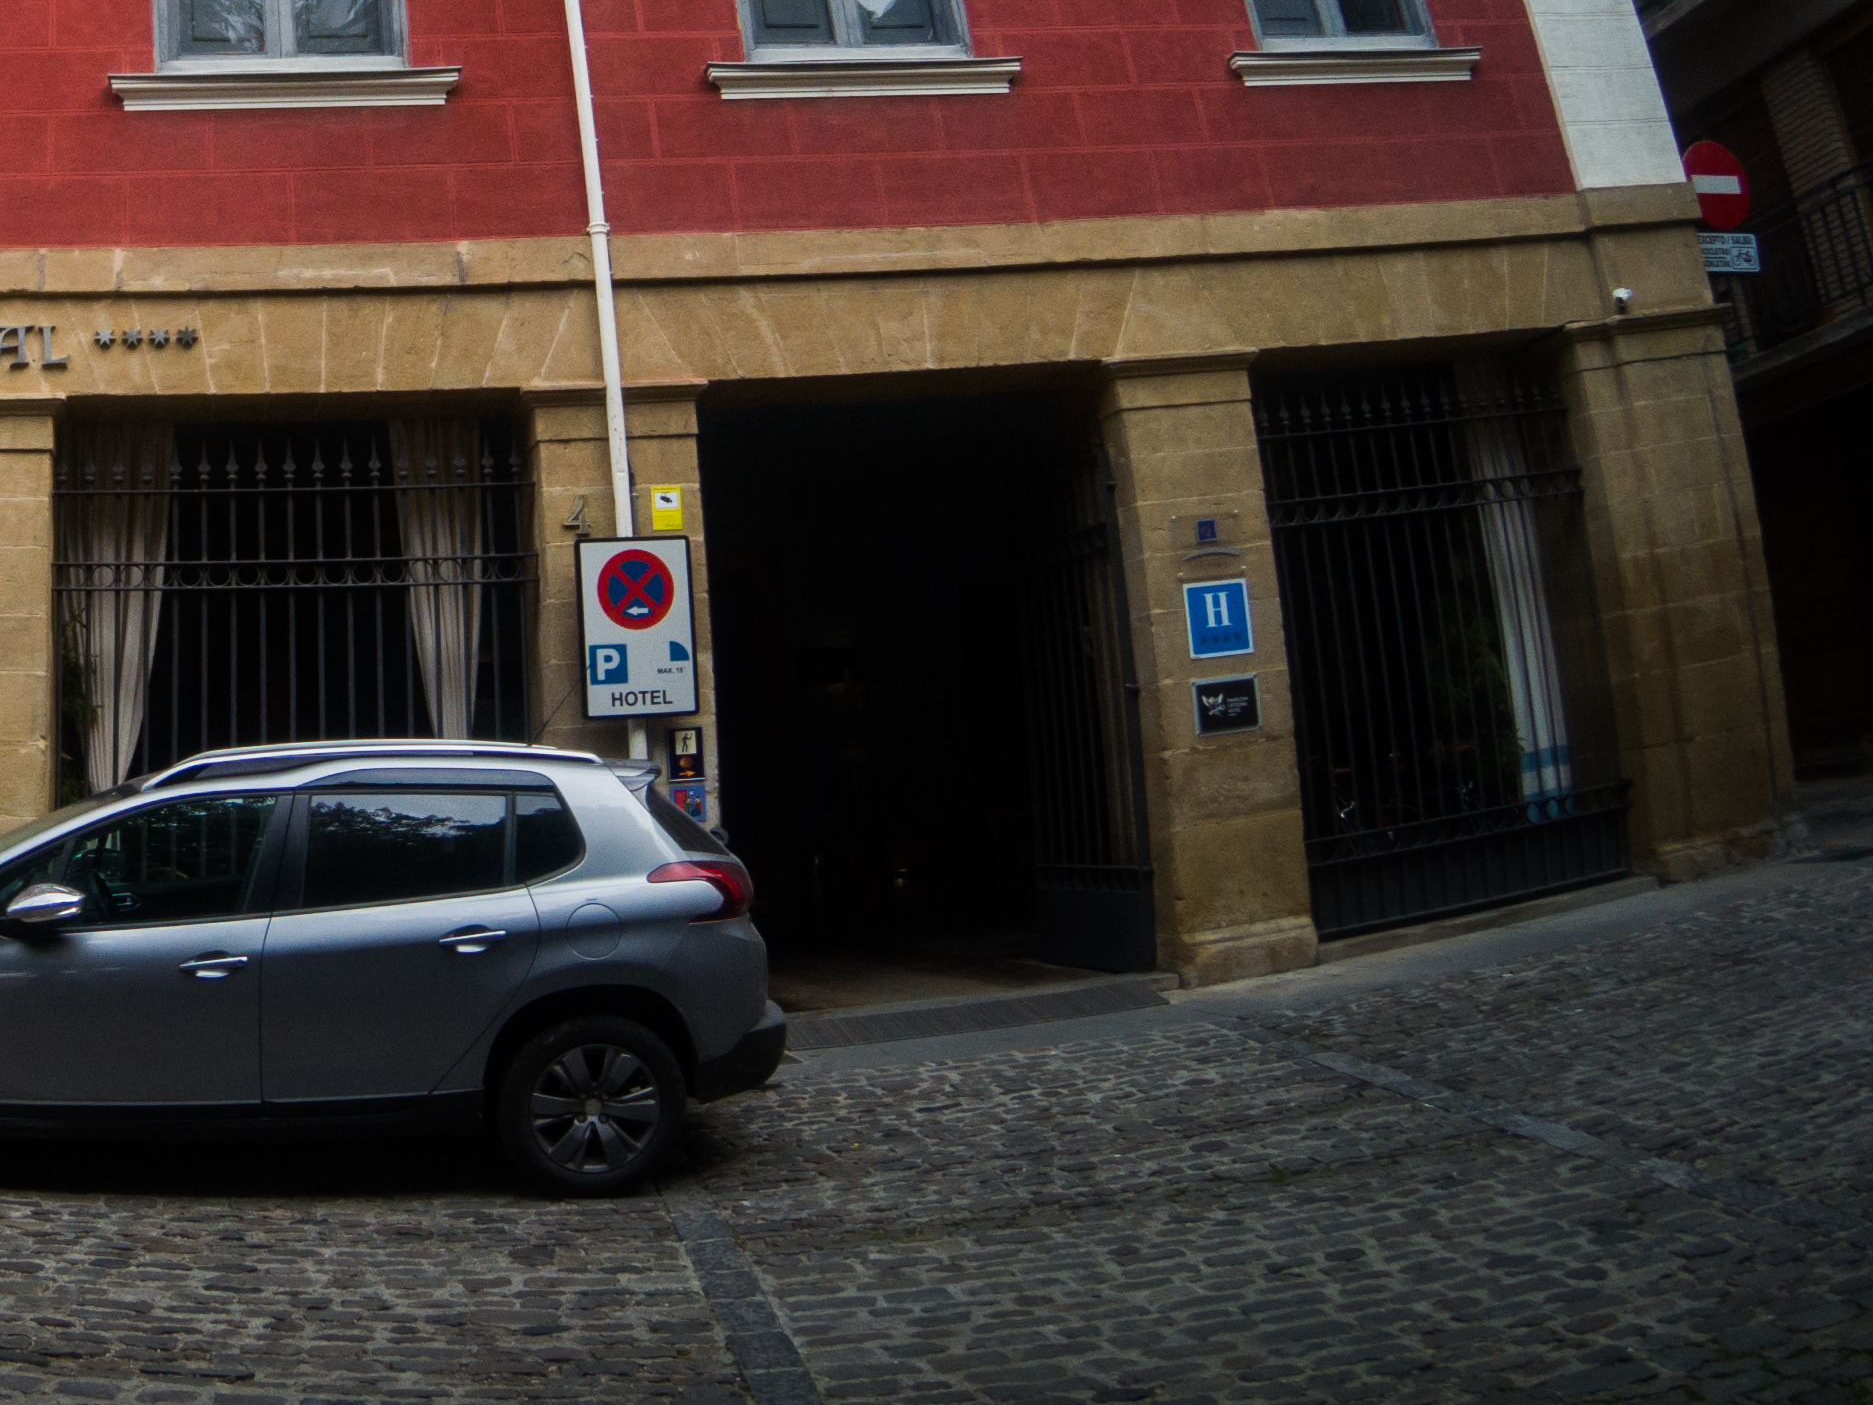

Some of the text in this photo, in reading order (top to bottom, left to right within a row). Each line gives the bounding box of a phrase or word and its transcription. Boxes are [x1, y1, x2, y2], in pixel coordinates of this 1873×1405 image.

[563, 494, 591, 536] 4
[1202, 591, 1233, 628] H
[596, 648, 621, 681] P
[611, 689, 674, 707] HOTEL
